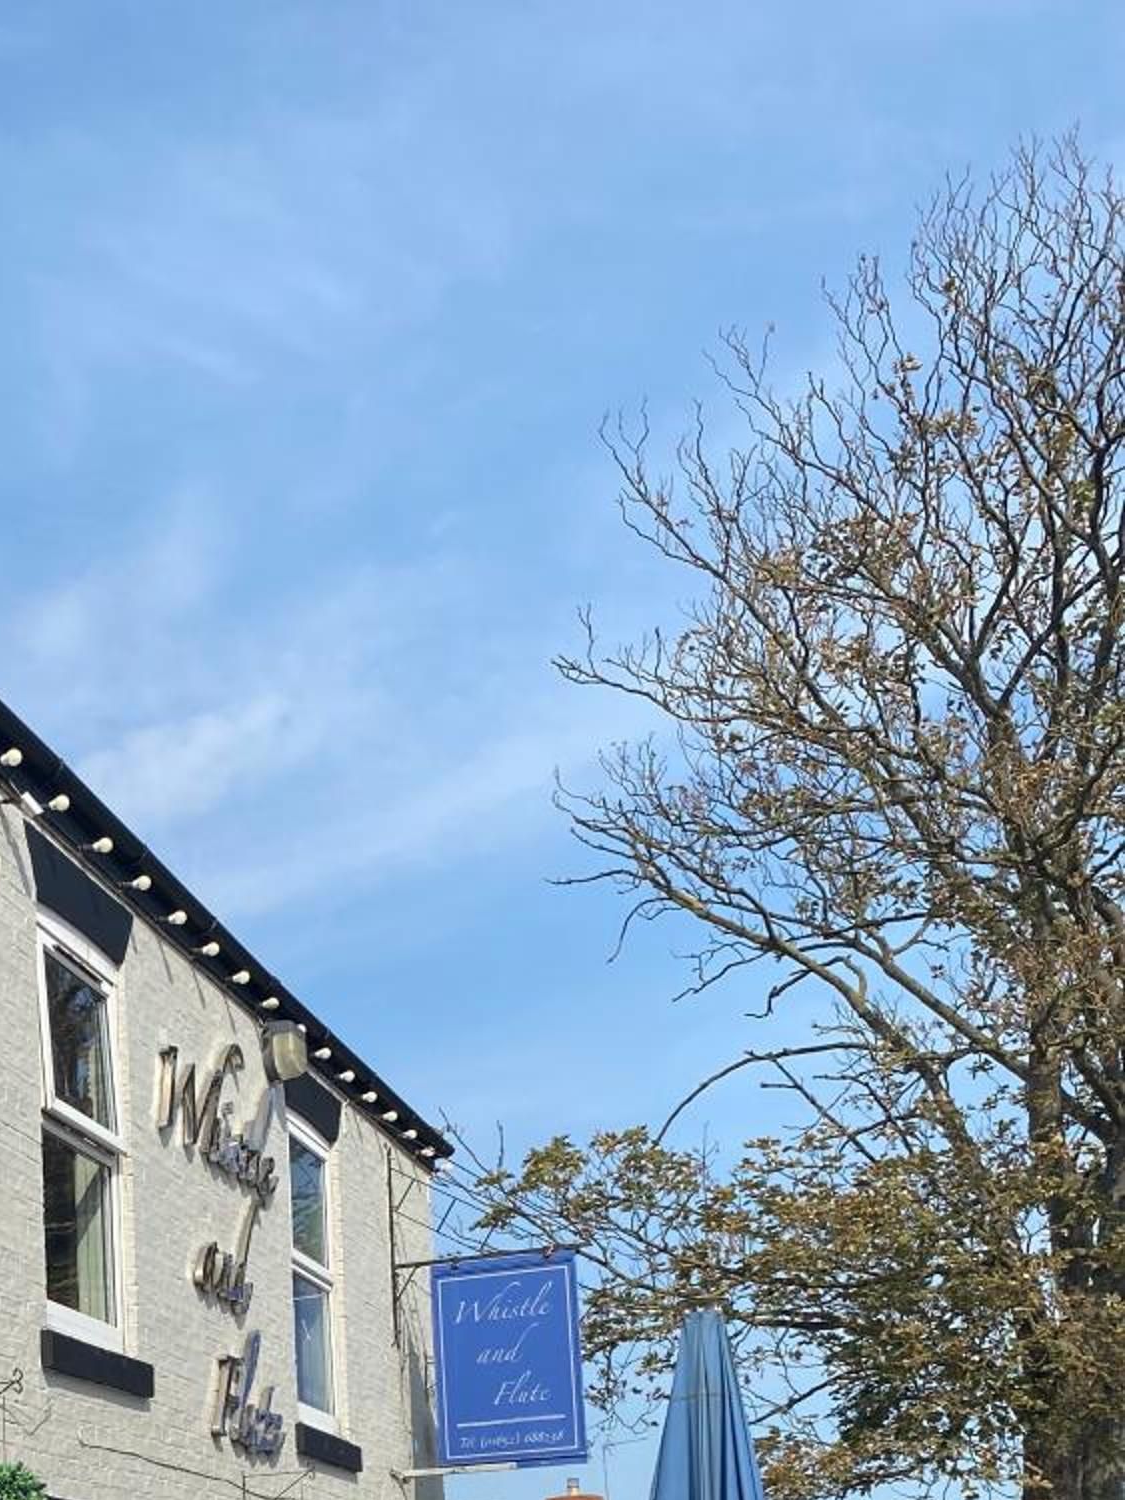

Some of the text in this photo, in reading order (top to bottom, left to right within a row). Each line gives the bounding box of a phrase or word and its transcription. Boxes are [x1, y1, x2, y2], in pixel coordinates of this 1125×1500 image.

[455, 1280, 552, 1324] Whistle
[476, 1322, 539, 1364] and
[494, 1369, 551, 1406] Flute
